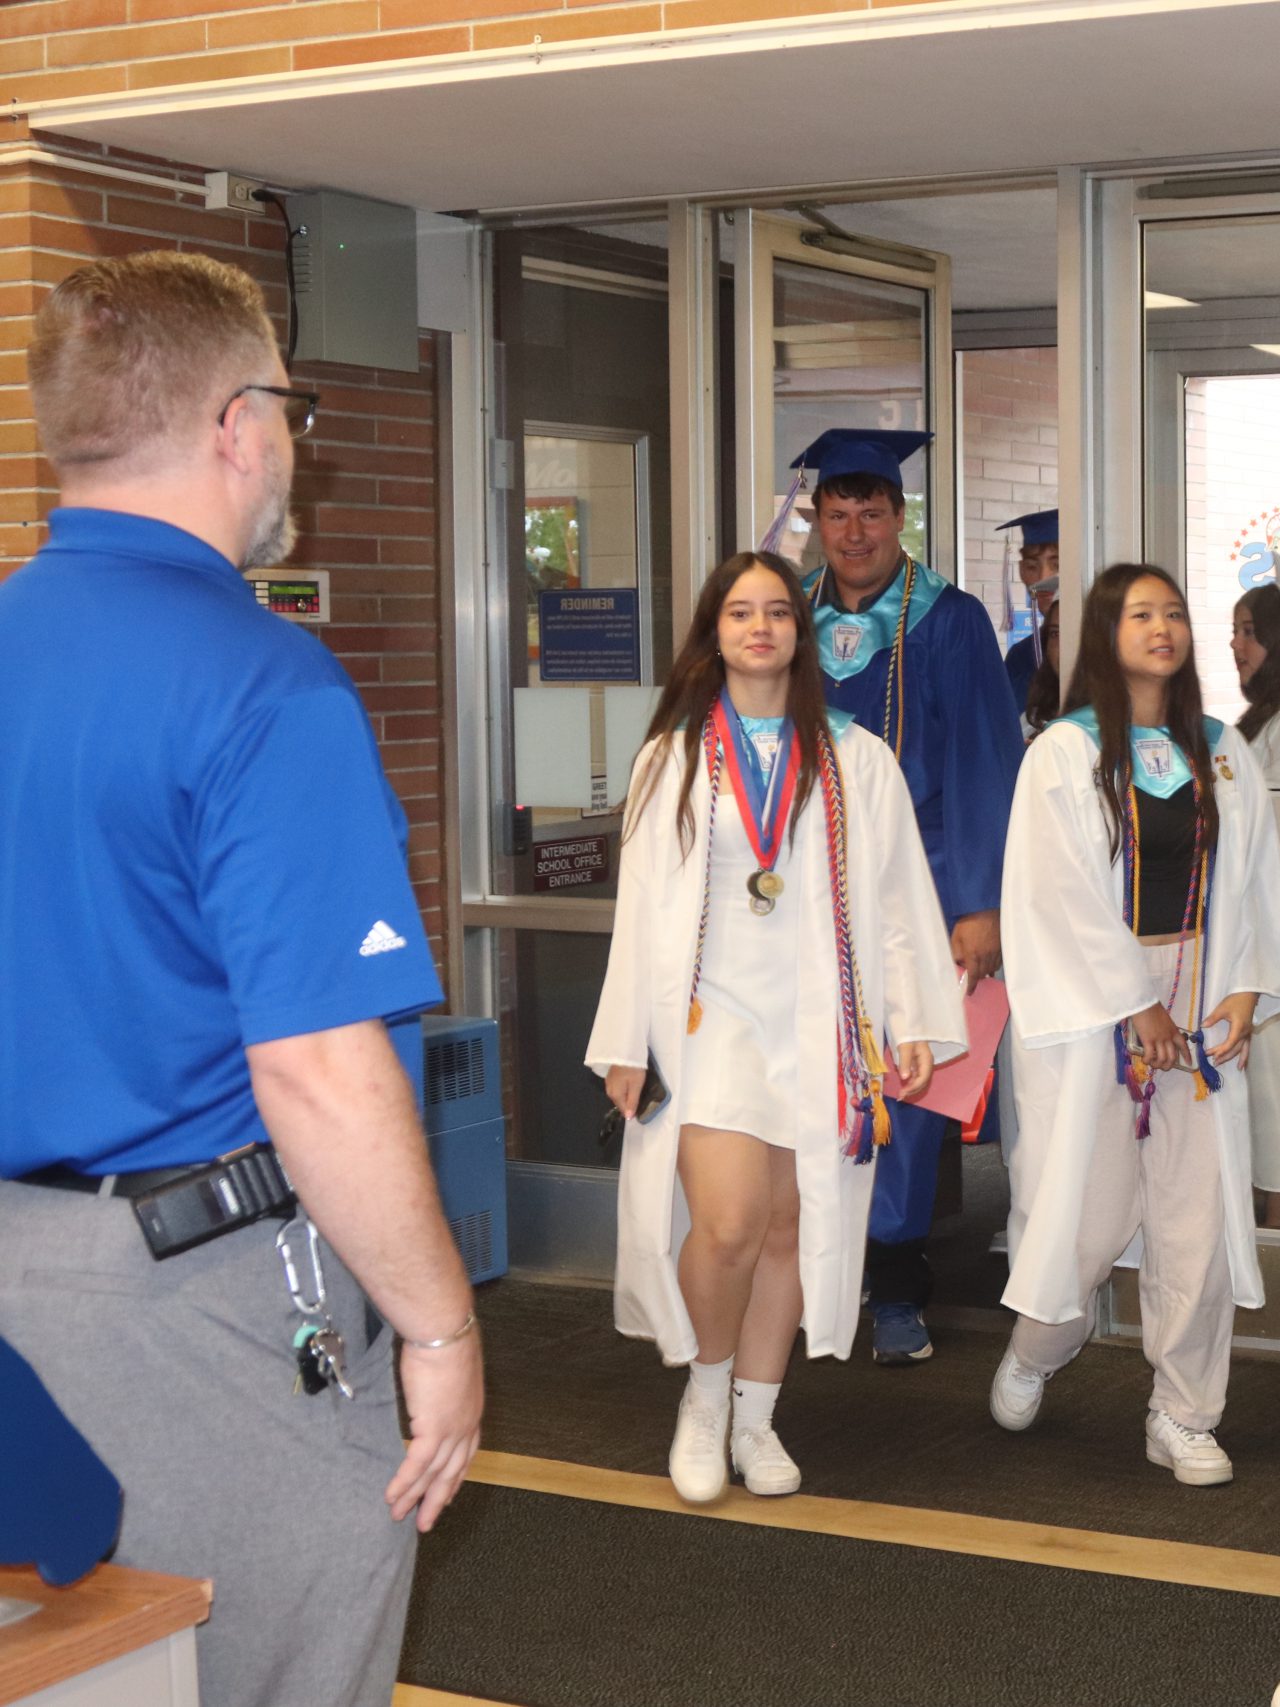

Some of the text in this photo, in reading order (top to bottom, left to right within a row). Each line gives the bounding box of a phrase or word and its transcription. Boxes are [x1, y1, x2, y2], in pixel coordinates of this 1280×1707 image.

[541, 841, 598, 859] INTERMEDIATE
[537, 854, 602, 873] SCHOOL OFFICE
[549, 871, 592, 887] ENTRANCE
